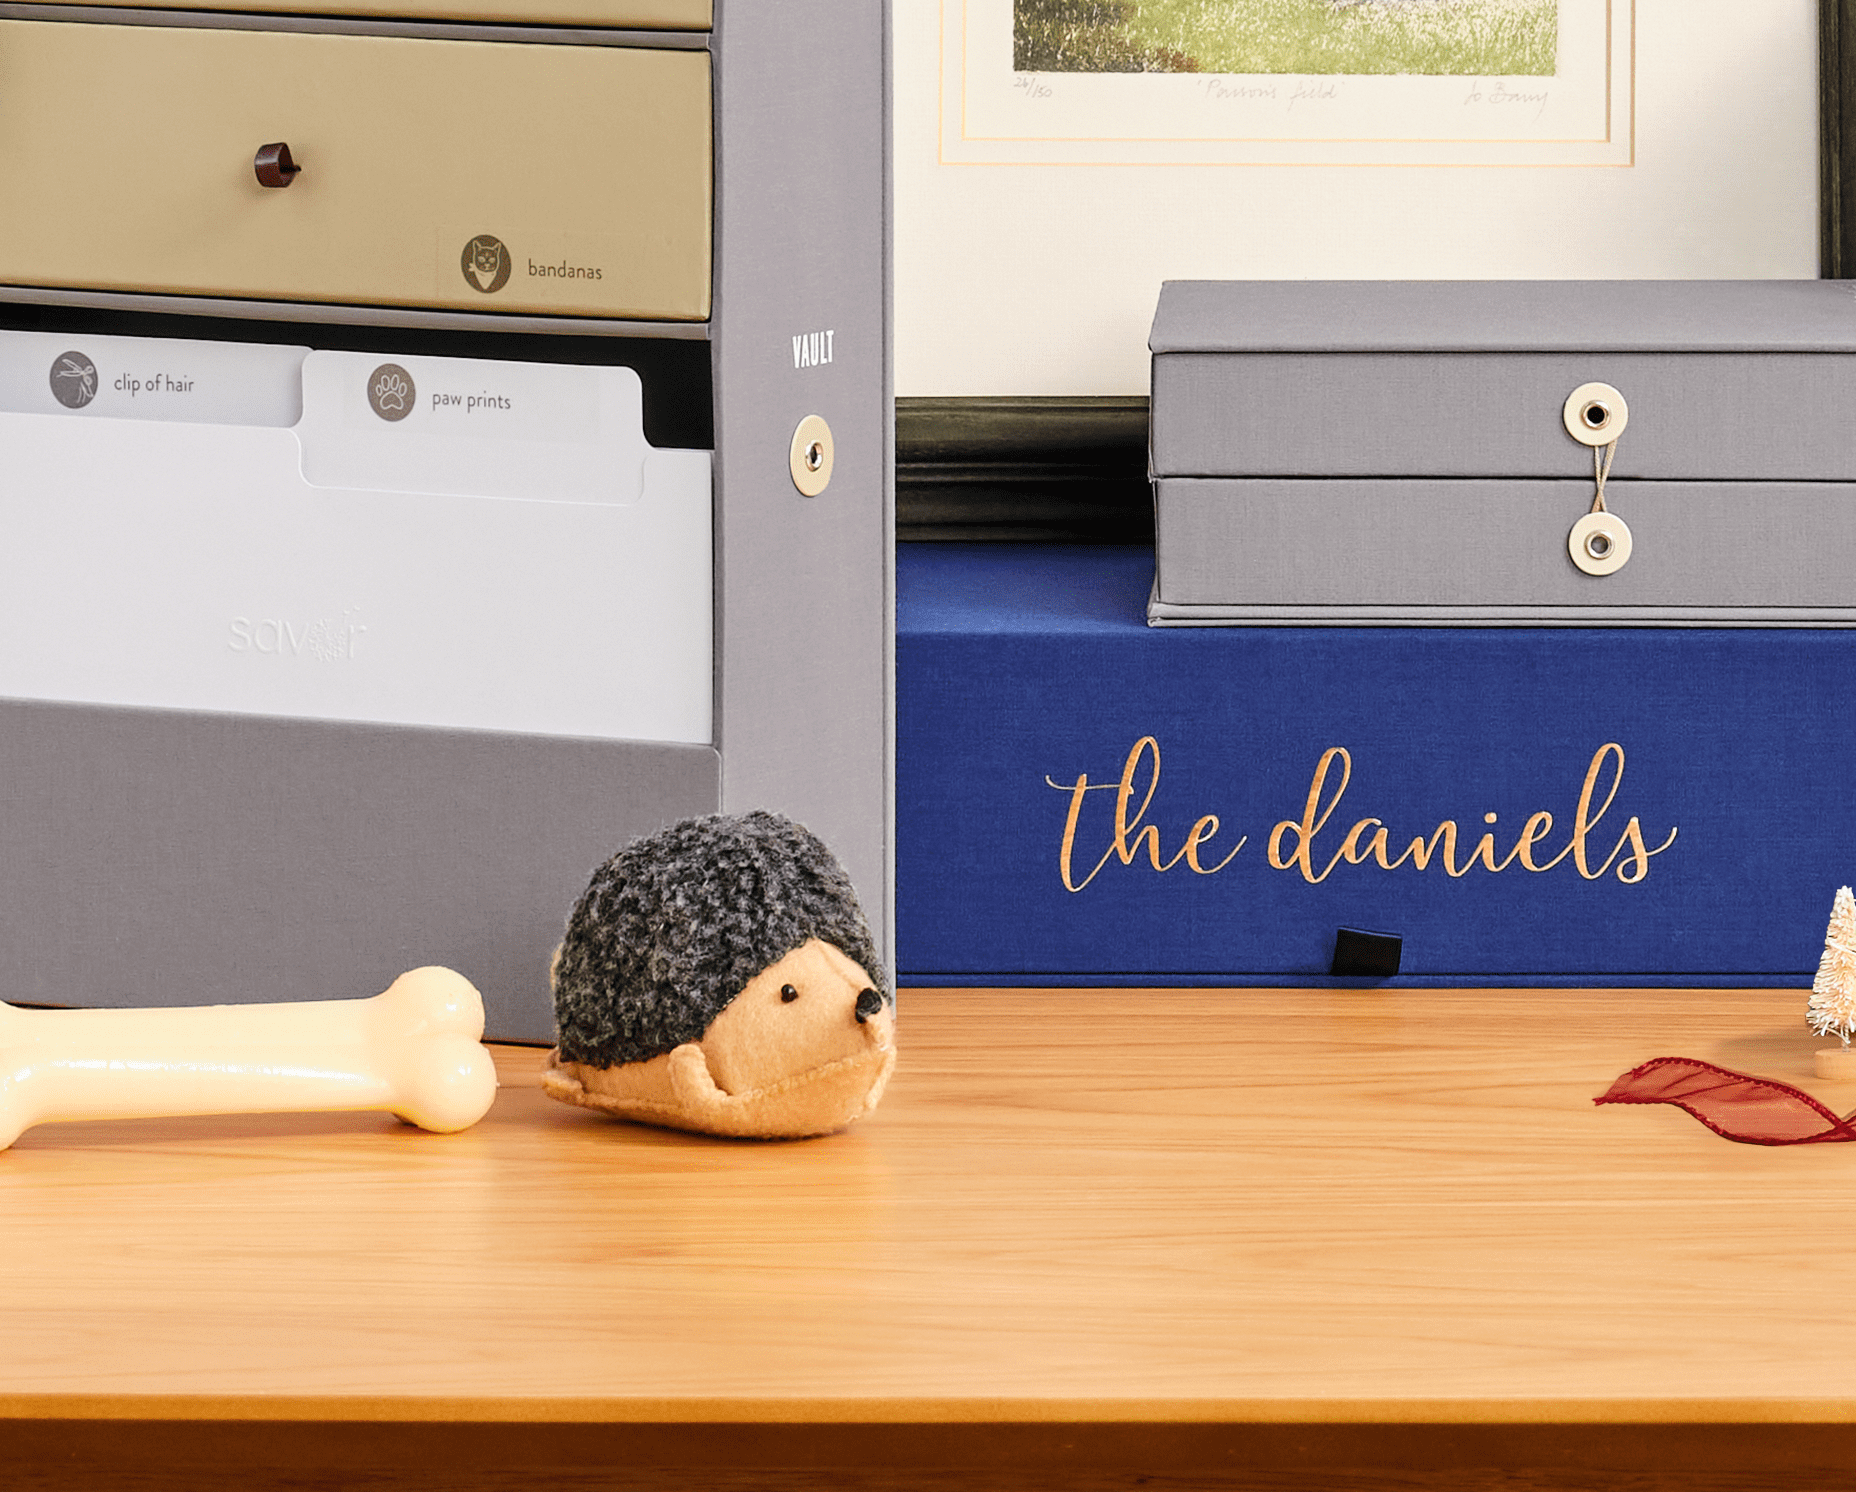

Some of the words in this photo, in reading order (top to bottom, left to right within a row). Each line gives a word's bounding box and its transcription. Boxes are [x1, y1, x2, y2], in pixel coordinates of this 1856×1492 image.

[528, 258, 603, 280] bandanas
[792, 329, 834, 369] VAULT
[114, 372, 141, 397] clip
[145, 373, 163, 391] of
[166, 374, 195, 392] hair
[432, 392, 462, 412] paw
[467, 390, 511, 414] prints
[1046, 735, 1246, 892] the
[1266, 742, 1678, 884] daniels
